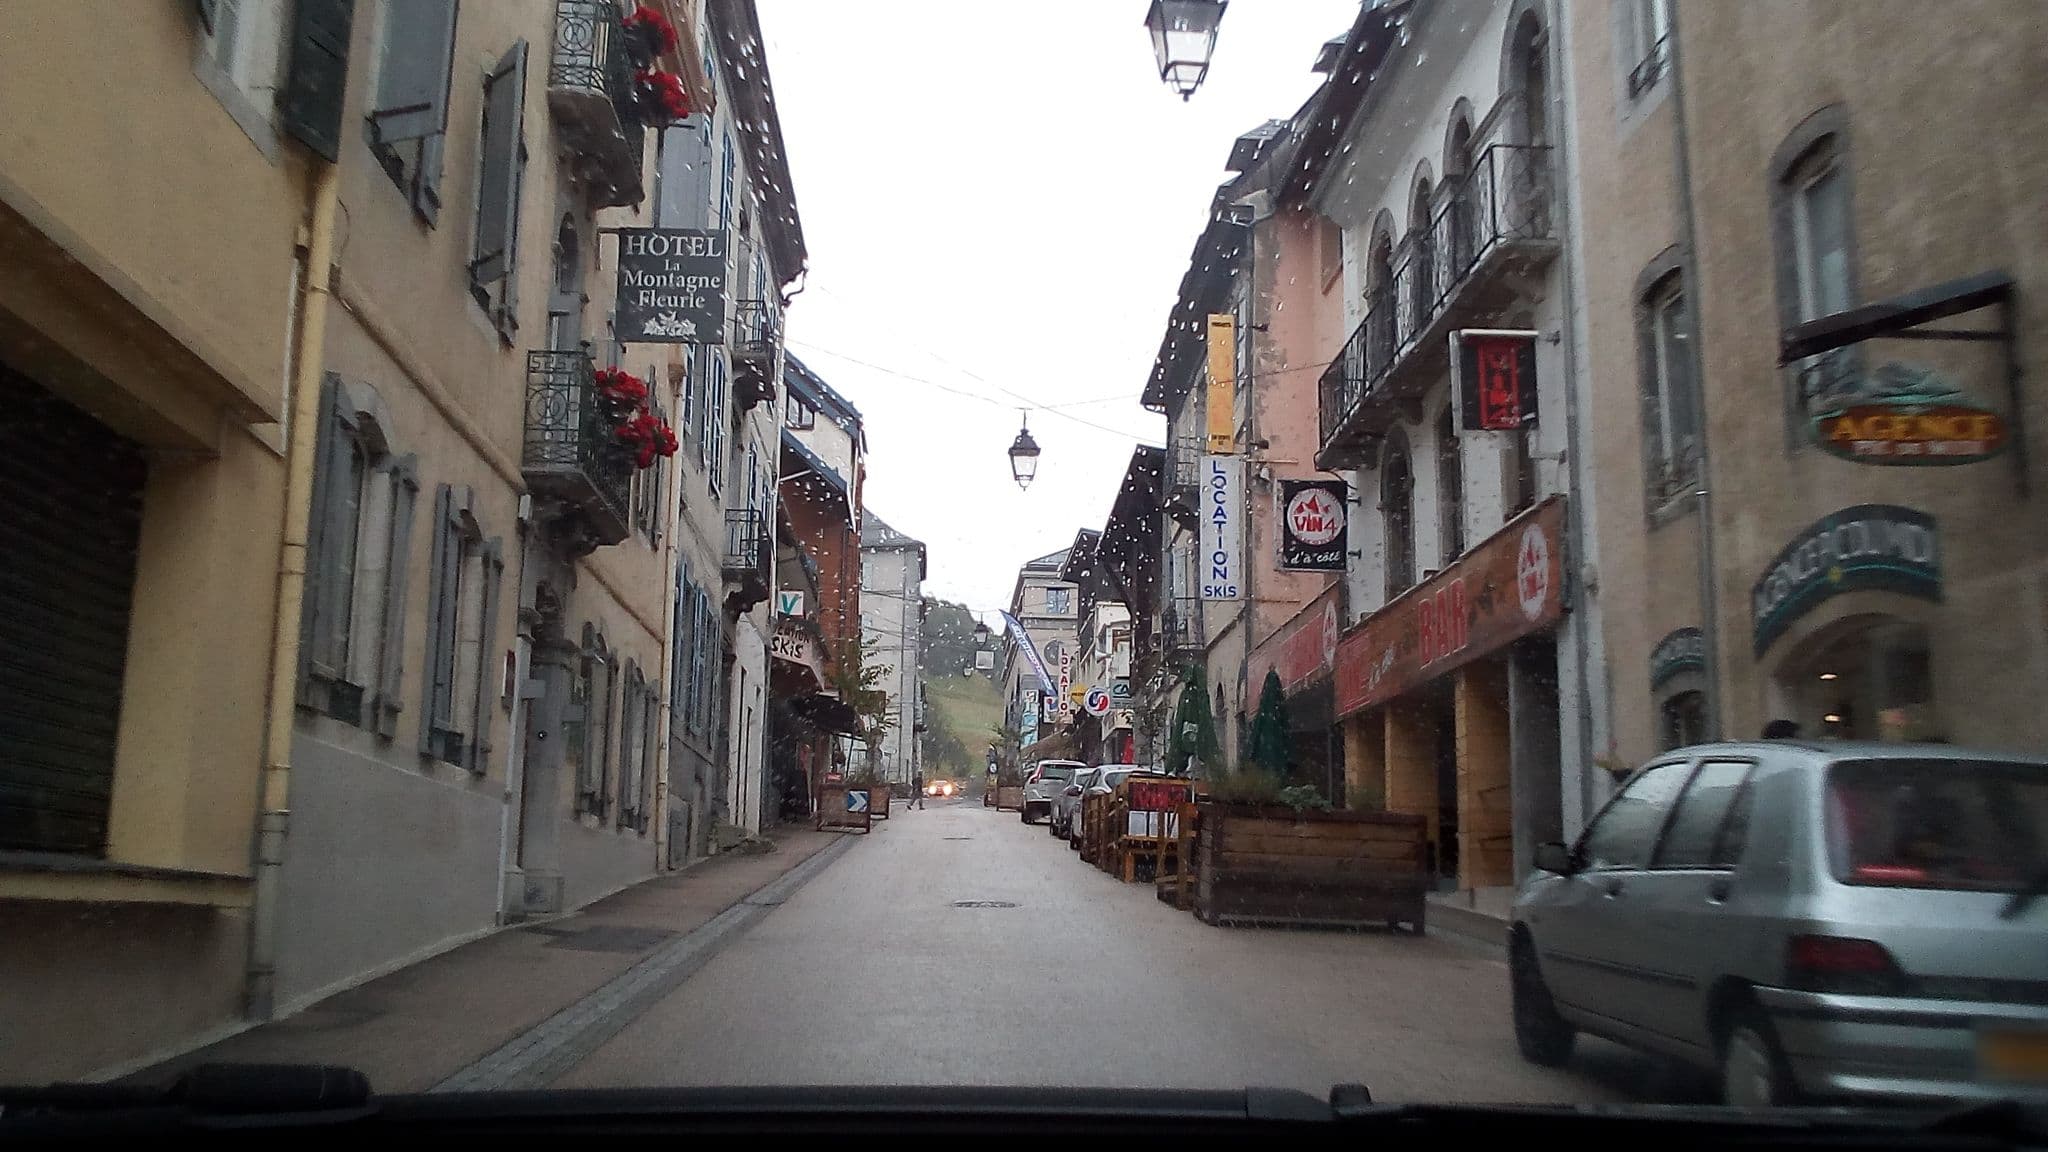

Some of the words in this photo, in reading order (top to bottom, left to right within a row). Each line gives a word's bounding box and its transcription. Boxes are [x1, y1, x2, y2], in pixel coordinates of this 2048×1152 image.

[664, 259, 680, 272] La
[624, 270, 721, 293] Montagne
[639, 290, 706, 309] Fleurie
[1211, 460, 1228, 581] LOCATION
[1204, 585, 1238, 598] SKIS
